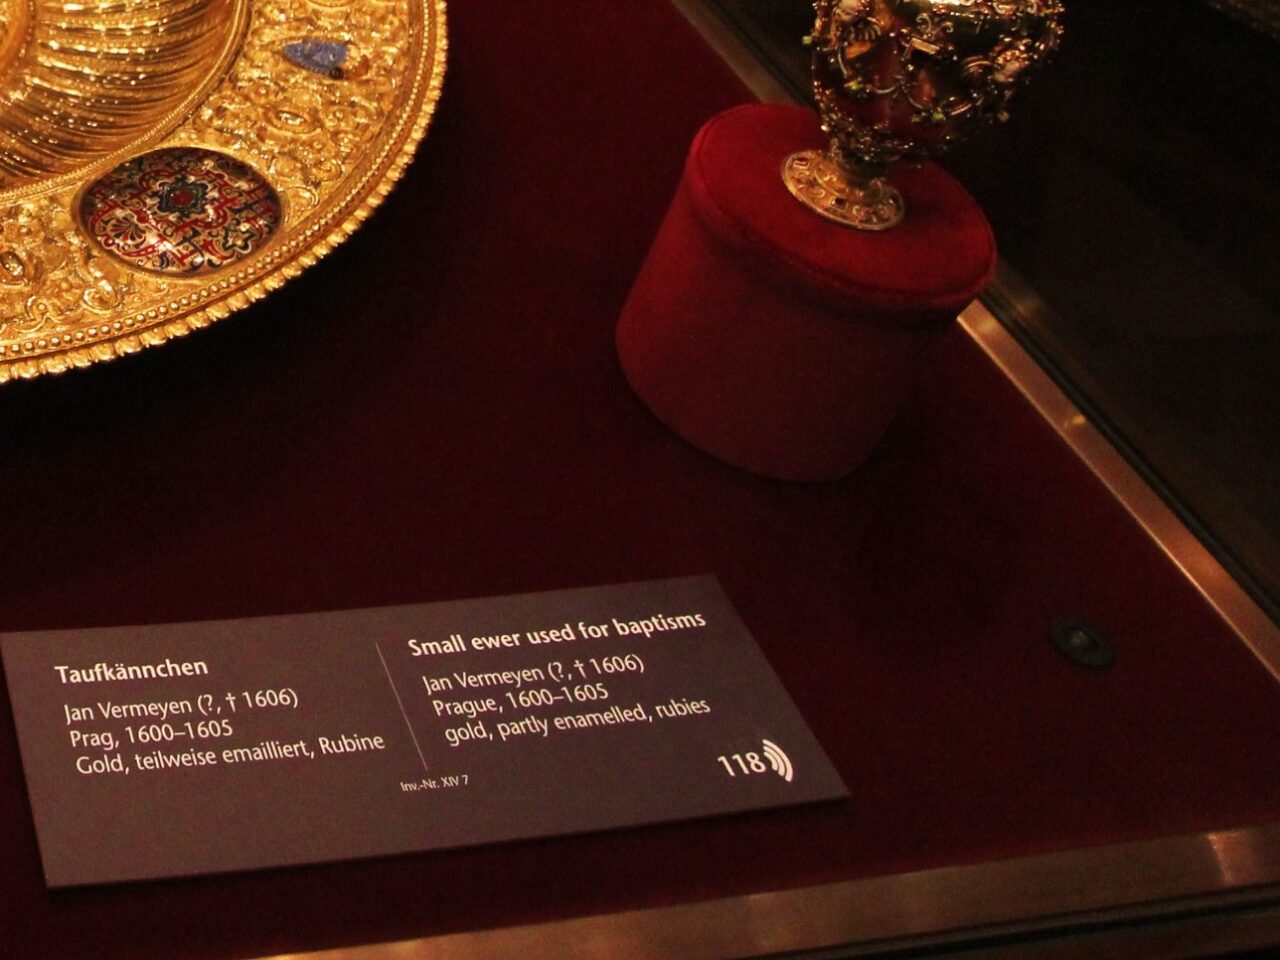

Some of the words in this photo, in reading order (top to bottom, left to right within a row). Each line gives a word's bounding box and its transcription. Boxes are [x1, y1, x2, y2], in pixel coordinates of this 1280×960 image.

[408, 634, 466, 656] Small
[471, 633, 520, 650] ewer
[526, 623, 576, 644] used
[578, 622, 608, 639] for
[612, 614, 706, 638] baptisms
[54, 659, 208, 683] Taufkännchen
[422, 676, 453, 696] Jan
[453, 668, 545, 688] Vermeyen
[548, 662, 572, 682] (?,
[589, 654, 644, 674] 1606)
[64, 704, 94, 725] Jan
[97, 700, 192, 720] Vermeyen
[197, 694, 221, 716] (?,
[242, 688, 298, 708] 1606)
[432, 698, 503, 718] Prague,
[445, 721, 493, 747] gold,
[497, 715, 548, 741] partly
[554, 703, 652, 730] enamelled,
[655, 698, 711, 718] rubies
[70, 730, 119, 750] Prag,
[76, 753, 129, 775] Gold,
[134, 748, 217, 770] teilweise
[222, 740, 314, 763] emailliert,
[318, 734, 385, 754] Rubine
[717, 752, 766, 776] 118
[400, 779, 440, 791] Inv.-Nr.
[441, 776, 459, 787] XIV
[461, 774, 469, 785] 7
